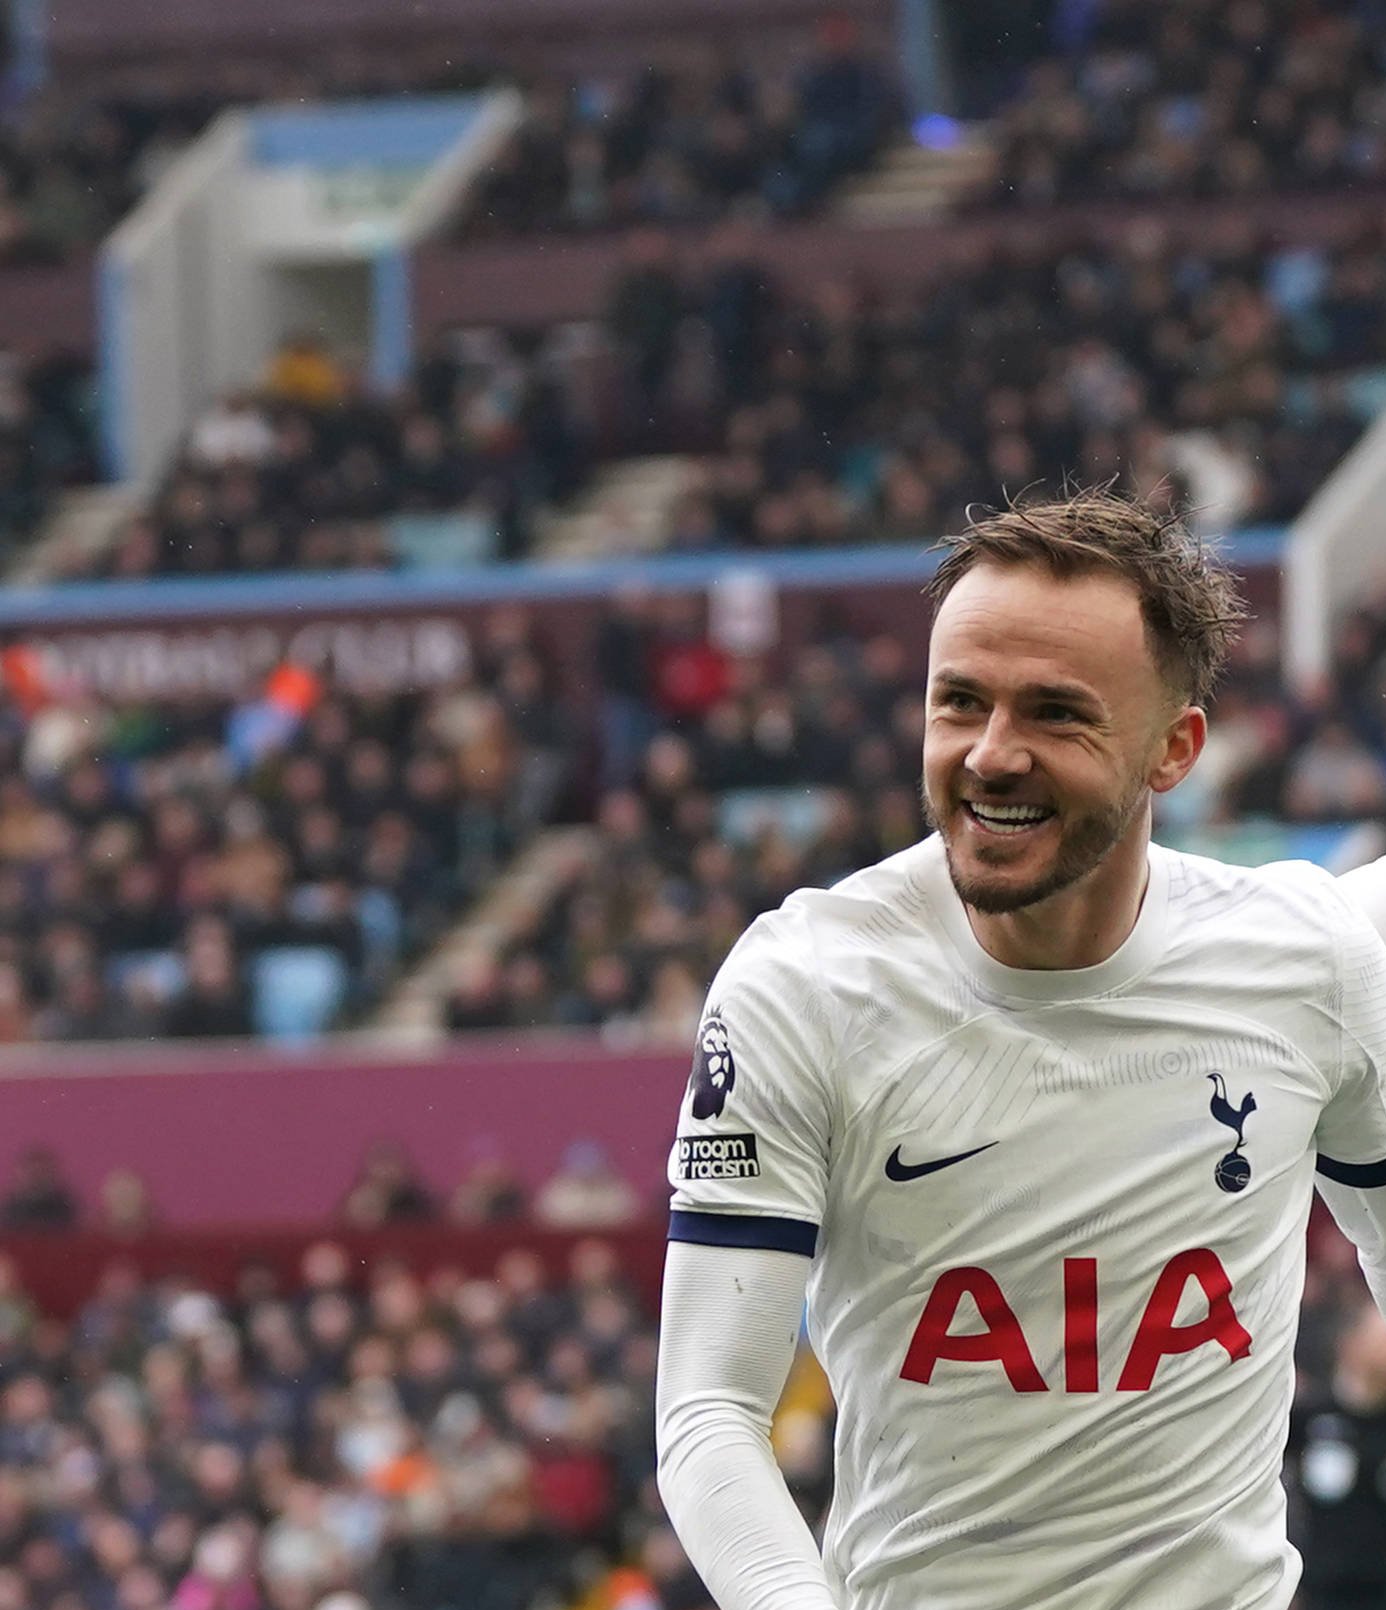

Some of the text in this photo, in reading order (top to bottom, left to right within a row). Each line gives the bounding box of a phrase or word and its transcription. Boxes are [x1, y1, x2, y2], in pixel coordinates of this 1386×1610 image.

[693, 1139, 746, 1158] room
[691, 1158, 759, 1179] racism
[899, 1247, 1253, 1393] AIA
